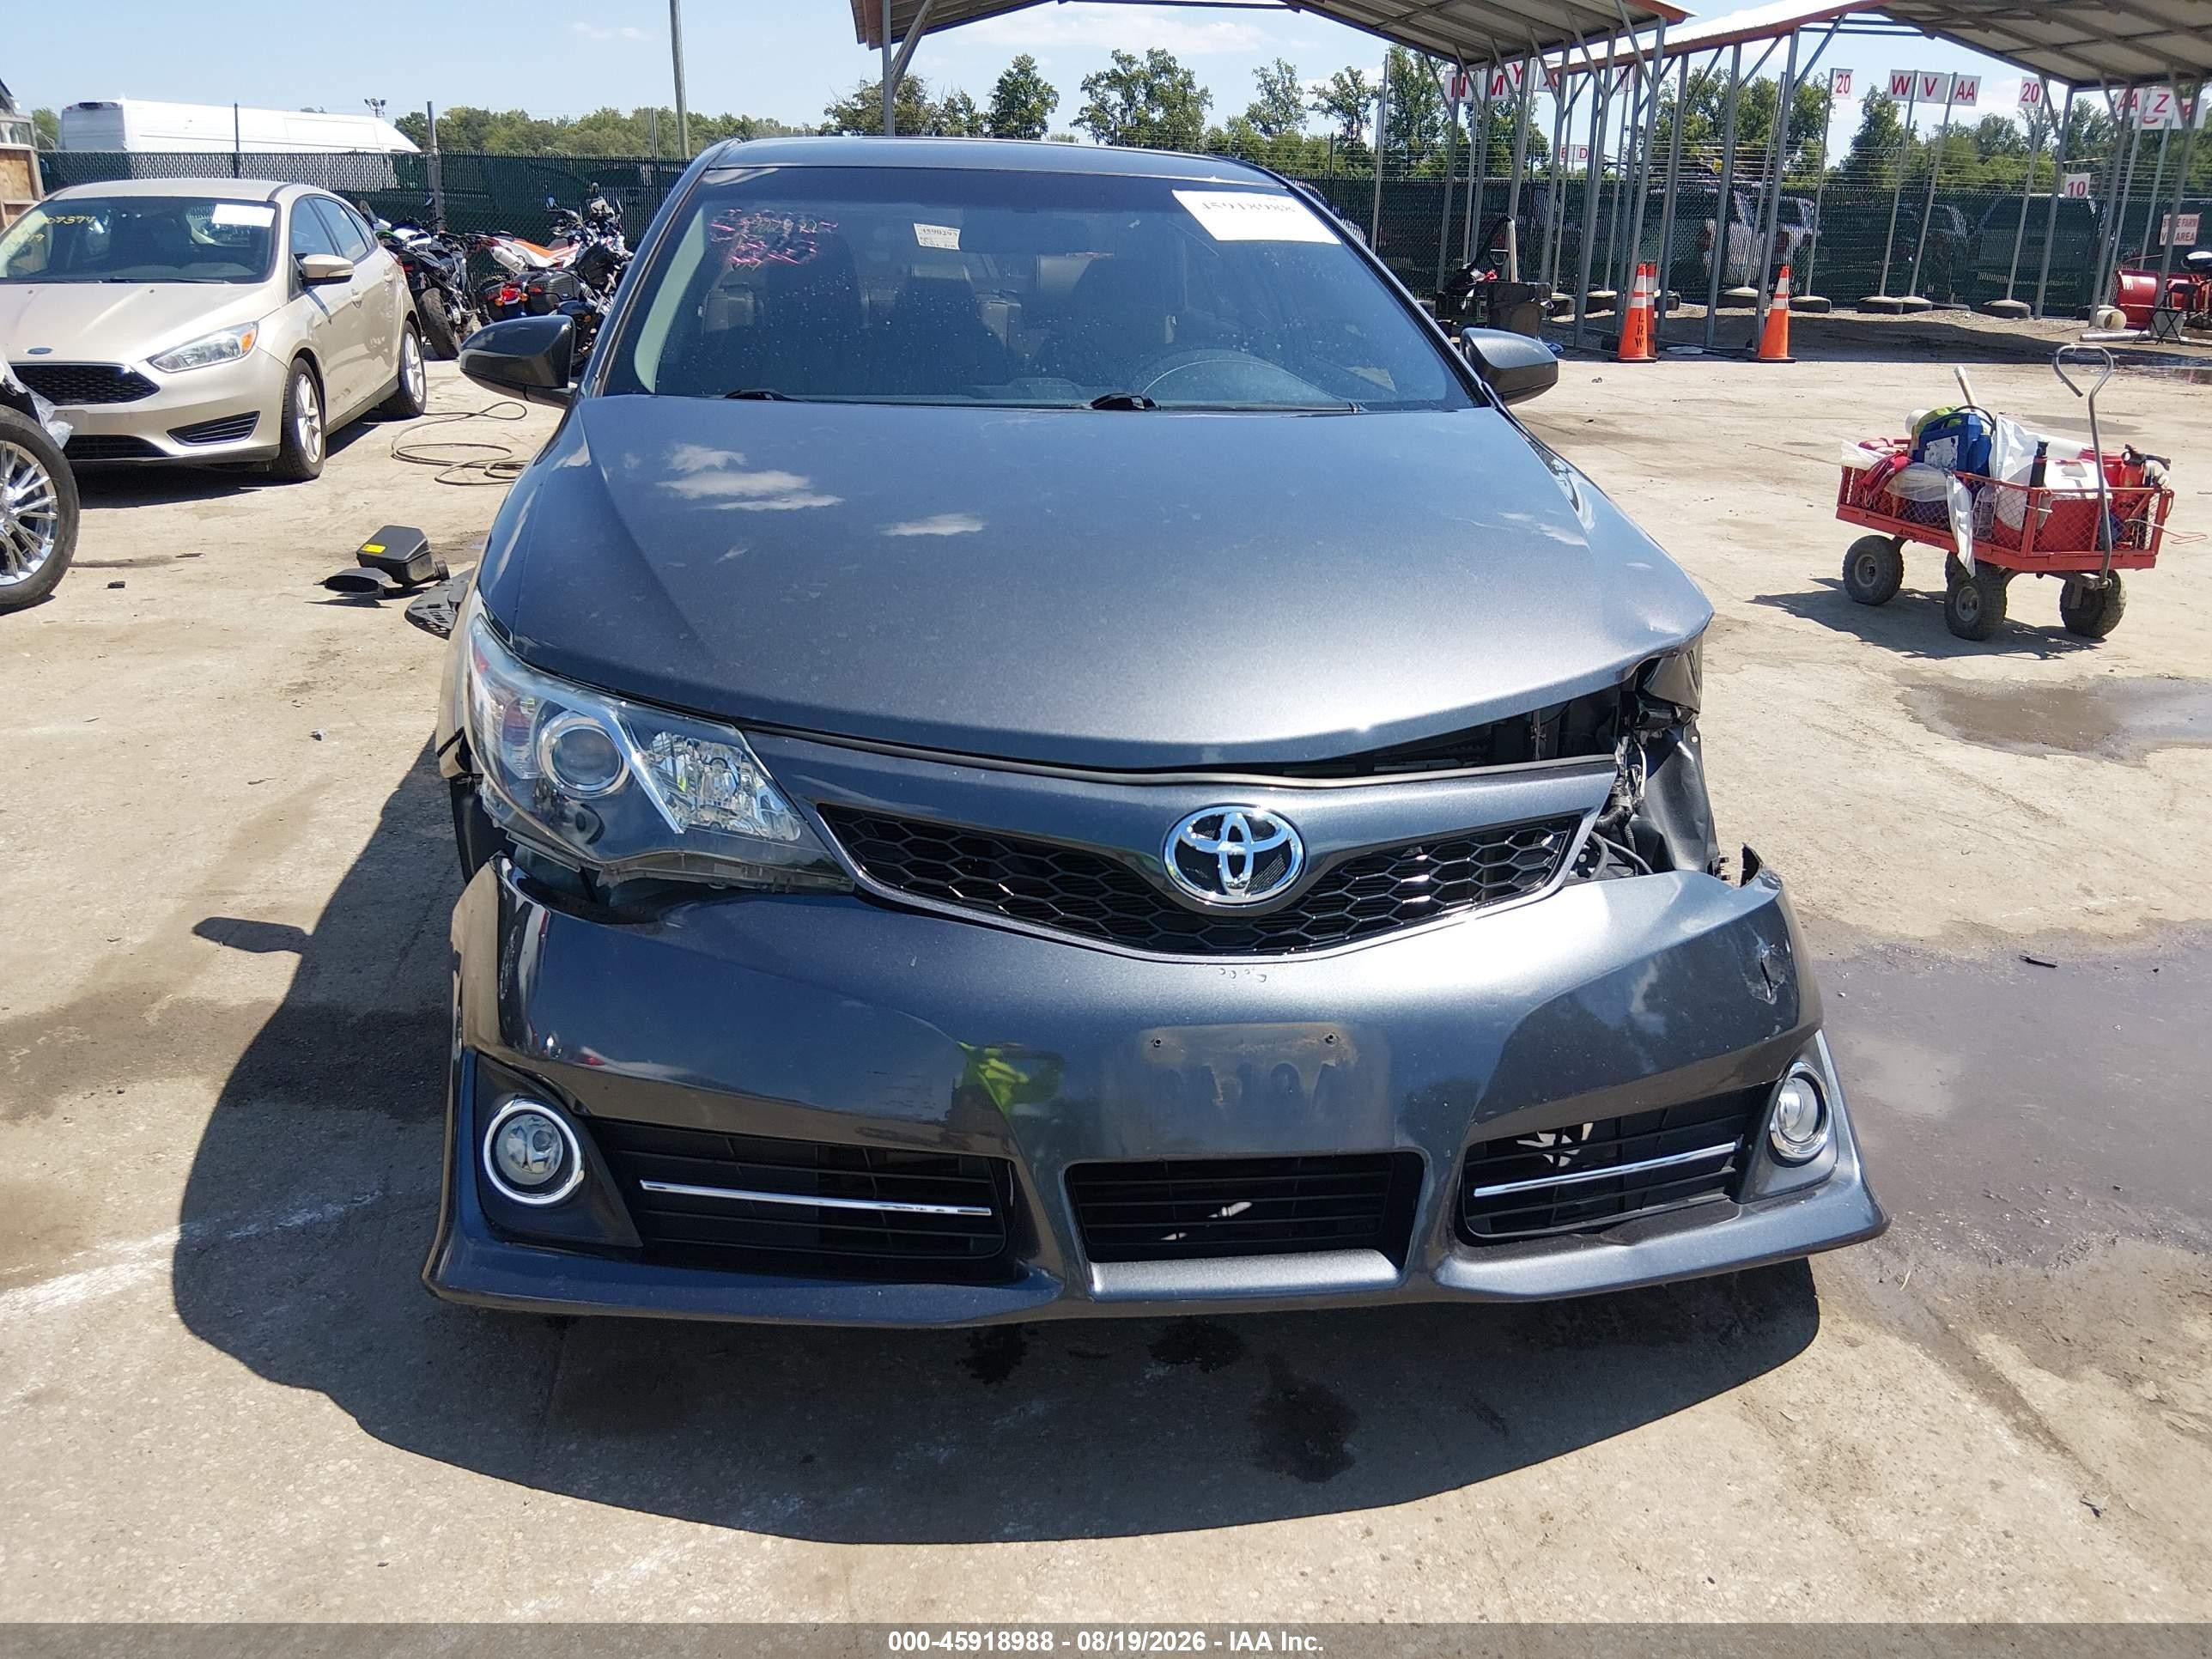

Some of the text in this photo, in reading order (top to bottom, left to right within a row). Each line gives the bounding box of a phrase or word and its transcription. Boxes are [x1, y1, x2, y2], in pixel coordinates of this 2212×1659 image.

[1836, 74, 1851, 94] 20
[1892, 75, 1911, 95] W
[1923, 77, 1938, 97] V
[1954, 80, 1975, 100] AA
[2020, 82, 2040, 103] 20
[2153, 94, 2170, 113] Z
[1579, 148, 1588, 159] D
[2068, 181, 2086, 197] 10
[2175, 232, 2195, 241] AREA
